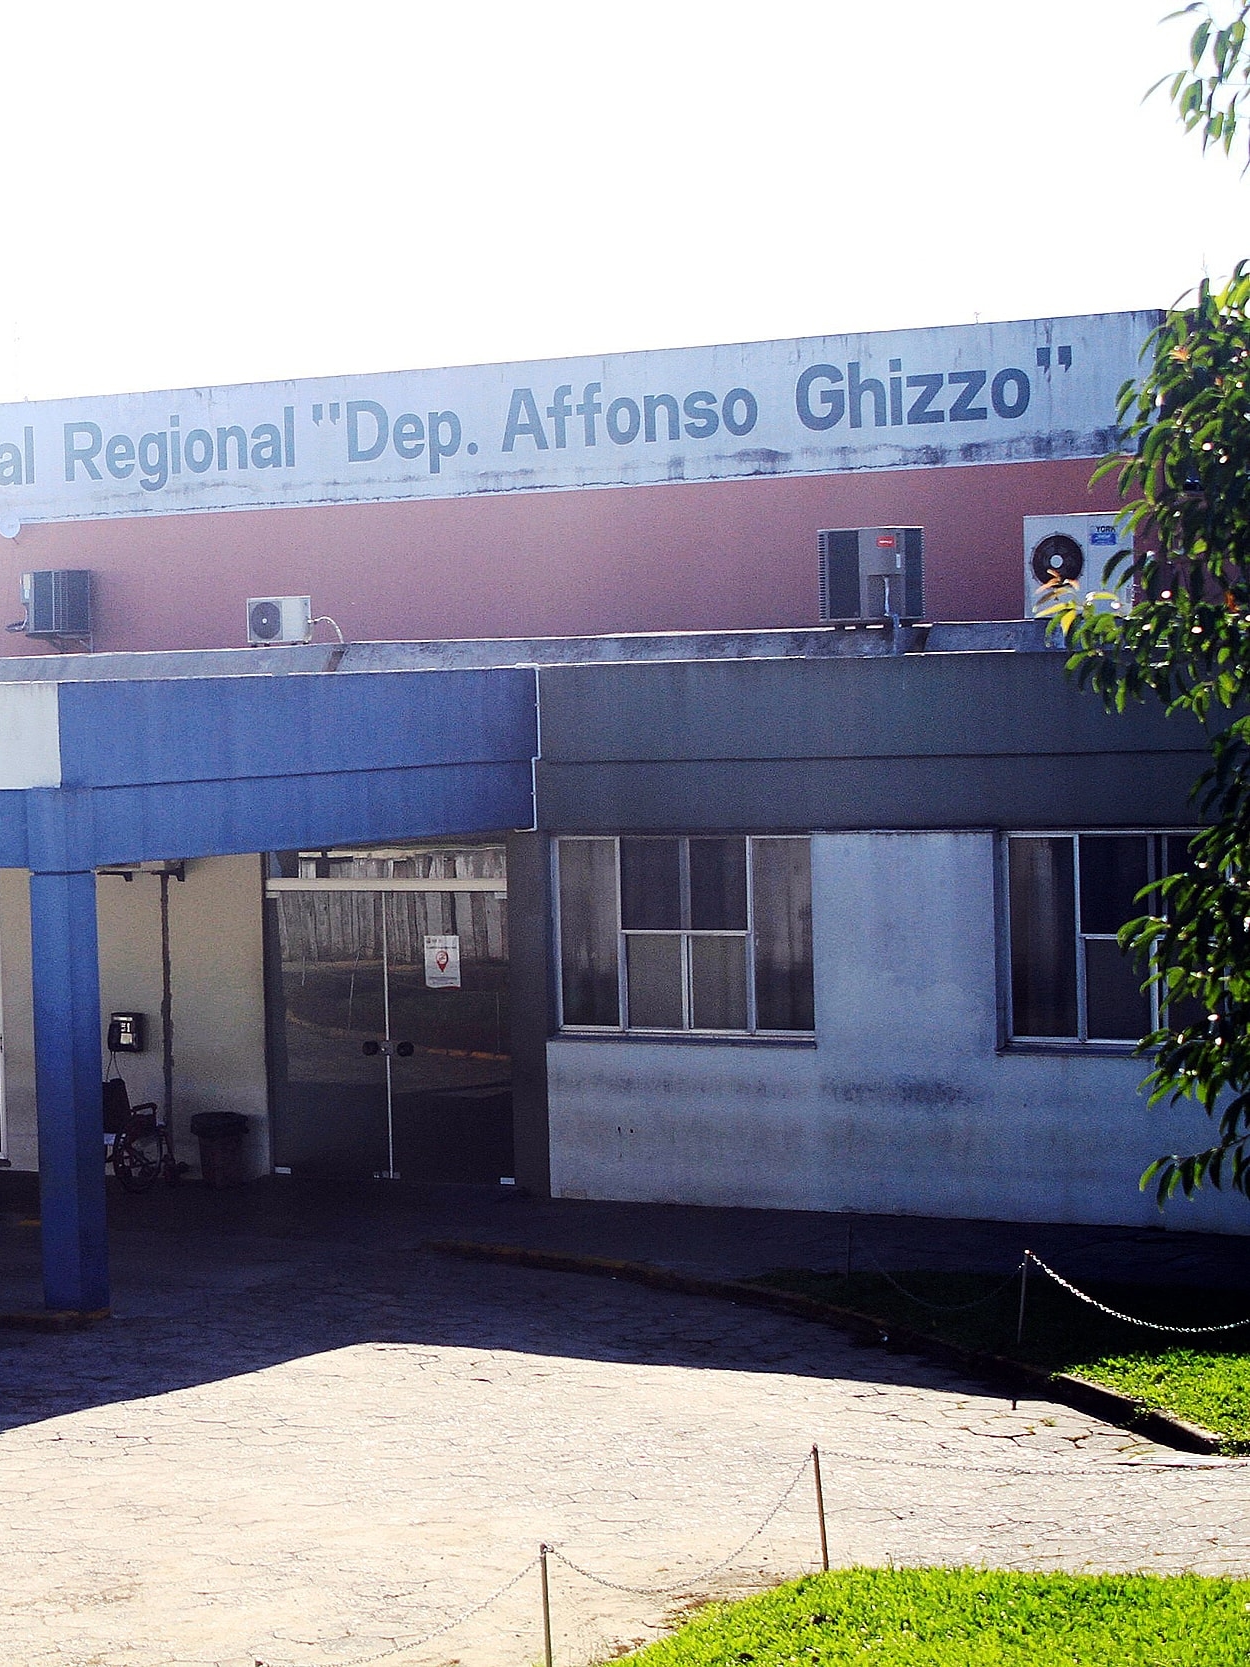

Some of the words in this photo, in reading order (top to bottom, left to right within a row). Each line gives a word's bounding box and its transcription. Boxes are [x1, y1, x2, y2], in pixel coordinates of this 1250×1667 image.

[64, 406, 295, 491] Regional
[312, 398, 478, 474] "Dep.
[501, 381, 757, 453] Affonso
[795, 345, 1072, 431] Ghizzo"
